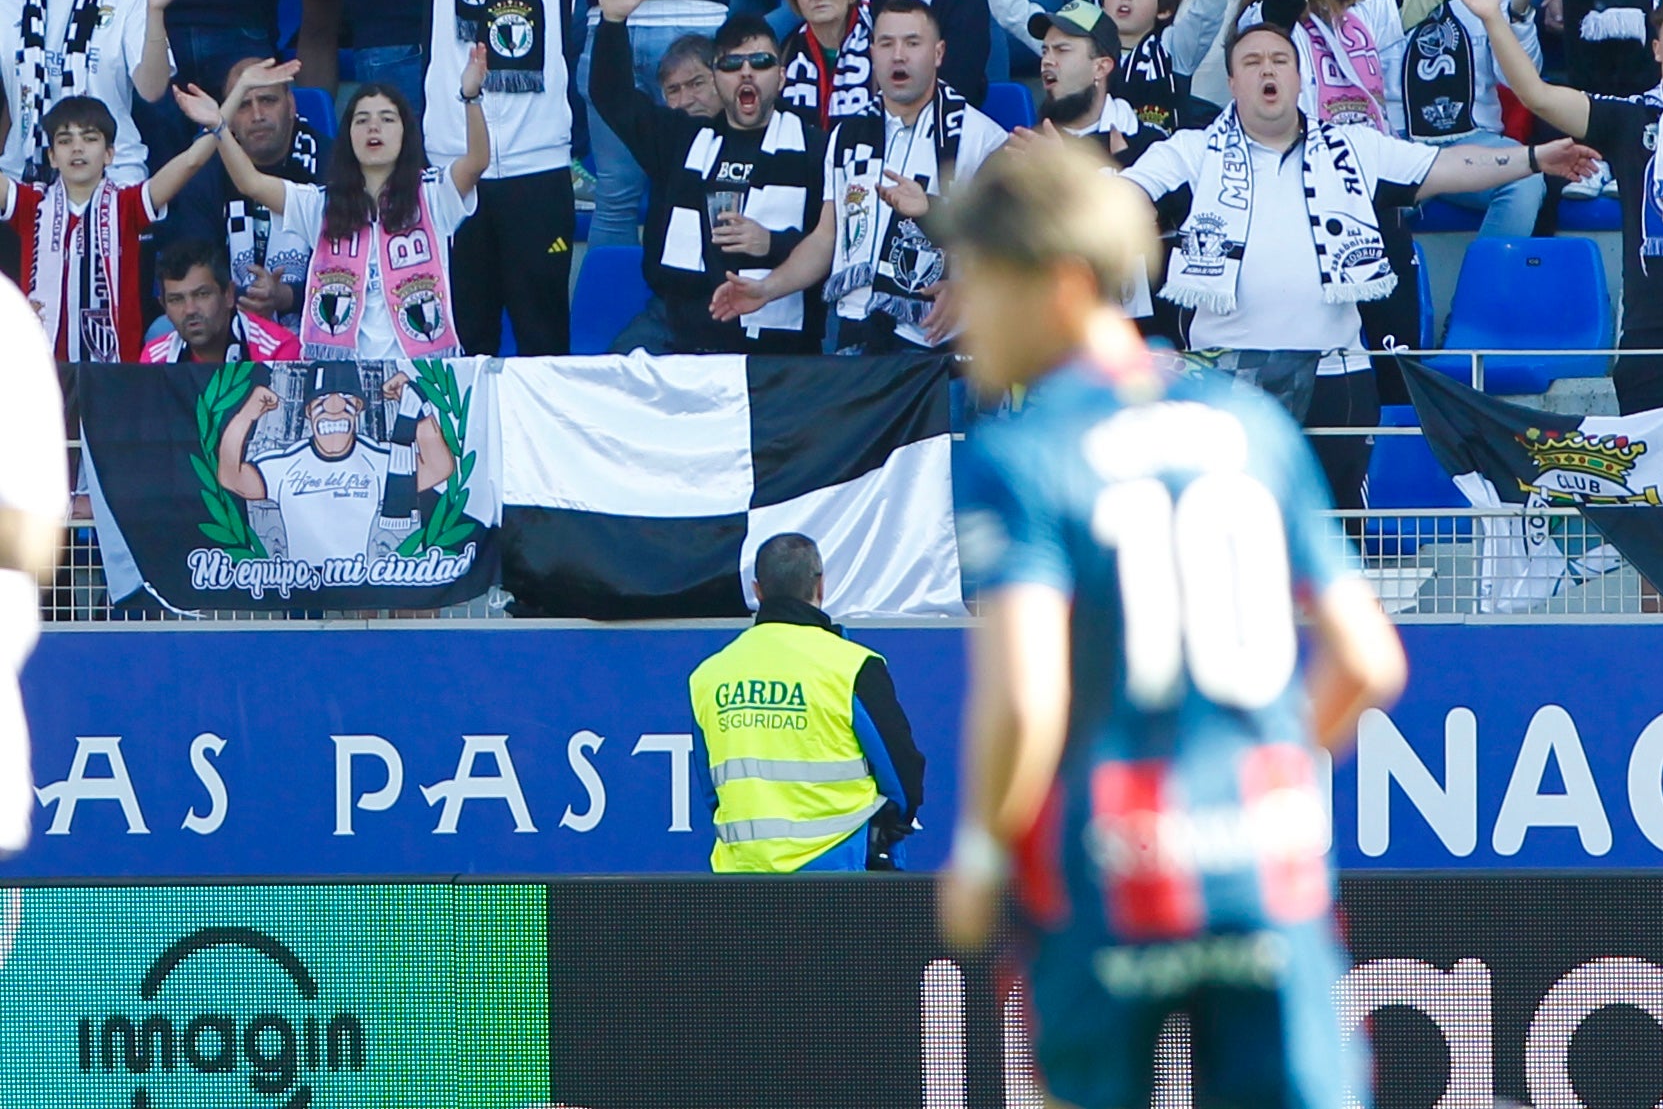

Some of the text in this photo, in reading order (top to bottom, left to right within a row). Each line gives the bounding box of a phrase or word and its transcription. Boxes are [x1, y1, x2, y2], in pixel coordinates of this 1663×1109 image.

[717, 161, 753, 180] BCF
[1555, 474, 1602, 495] CLUB
[188, 548, 236, 590] Mi
[322, 553, 369, 587] mi
[368, 542, 477, 586] ciudad
[1093, 472, 1298, 710] 10
[715, 680, 807, 709] GARDA
[79, 1013, 368, 1095] imagin
